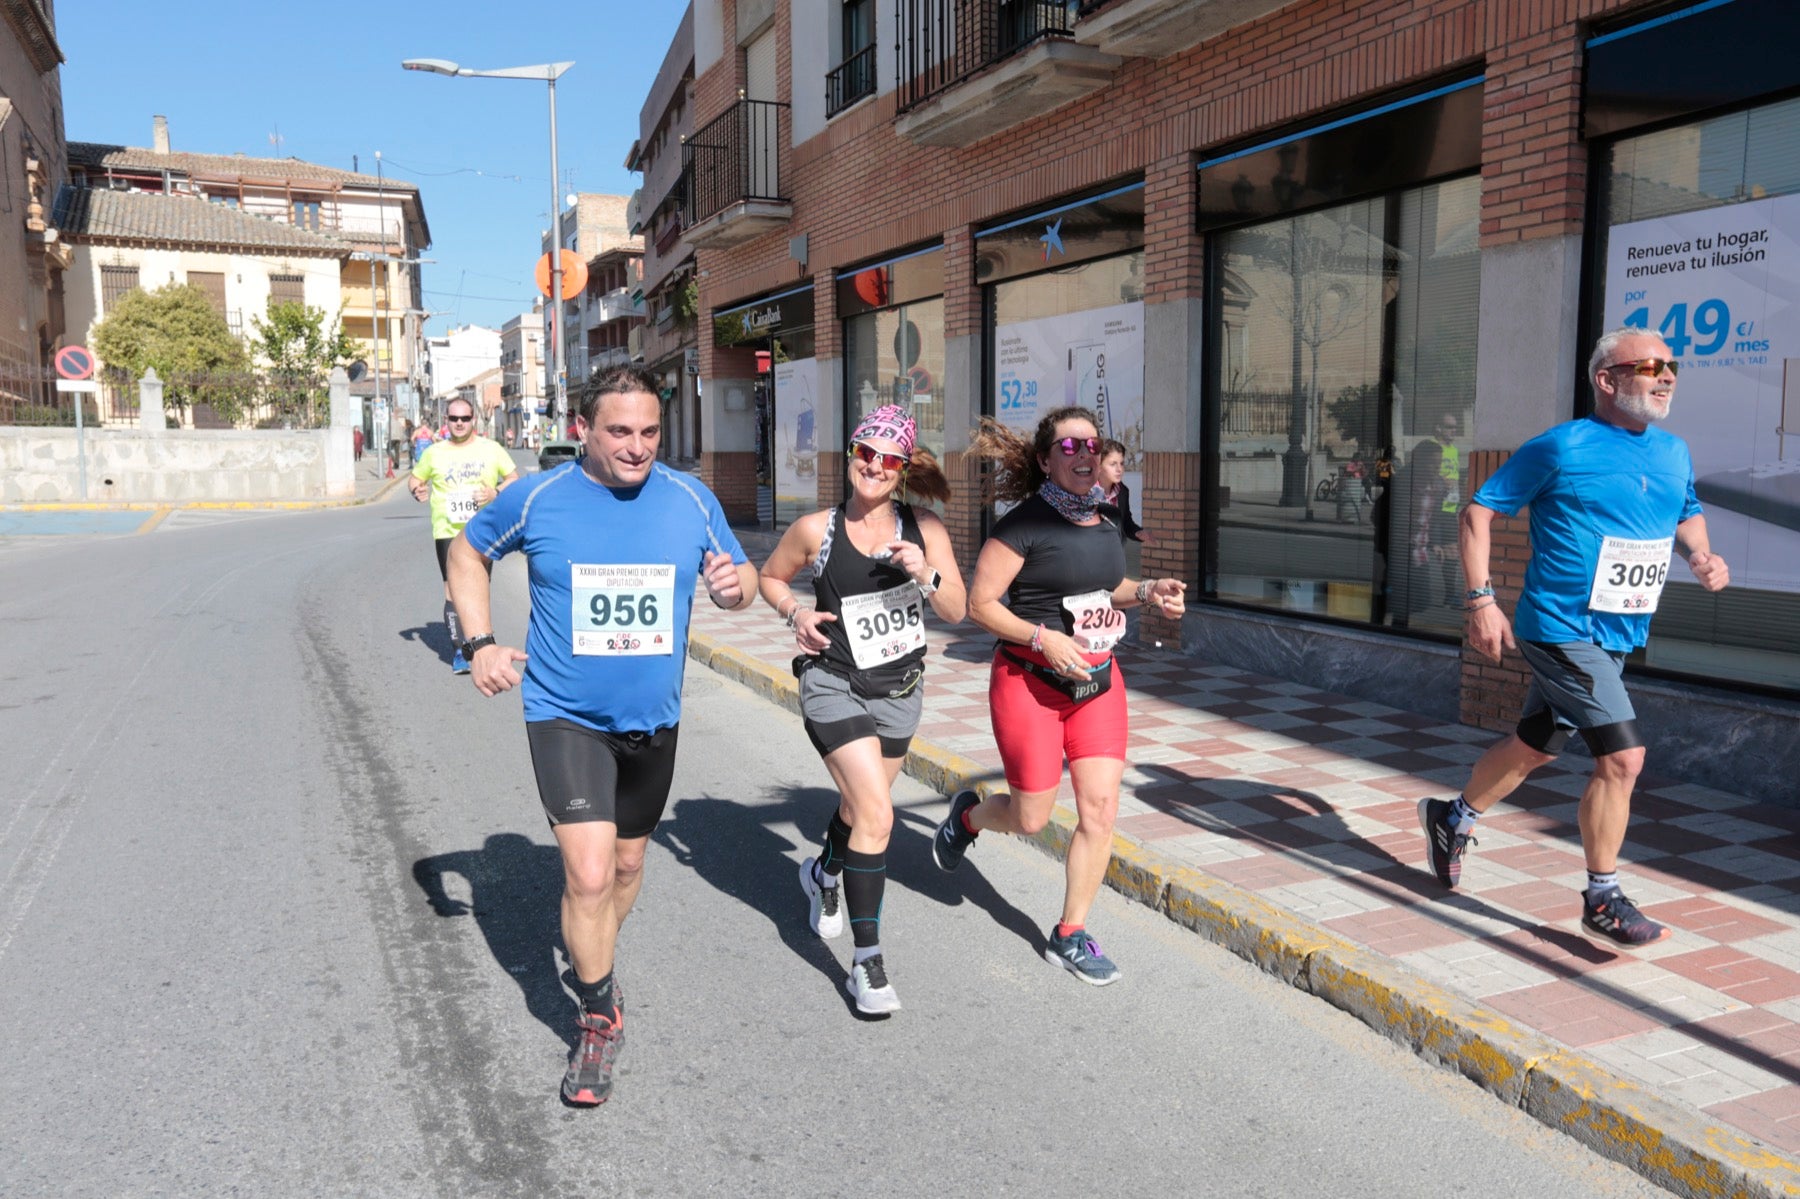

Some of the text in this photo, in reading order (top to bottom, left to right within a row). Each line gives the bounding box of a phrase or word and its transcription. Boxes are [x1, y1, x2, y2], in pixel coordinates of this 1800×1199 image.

[1628, 229, 1769, 260] Renueva tu hogar,
[1626, 246, 1766, 278] renueva tu ilusión
[1624, 290, 1647, 304] por
[752, 305, 782, 327] CaixaBank
[1734, 339, 1769, 353] mes
[1697, 359, 1710, 369] TIN
[598, 568, 615, 577] GRAN
[616, 568, 639, 577] PREMIO
[640, 568, 648, 577] DE
[1608, 562, 1666, 587] 3096
[590, 594, 658, 626] 956
[856, 603, 920, 641] 3095
